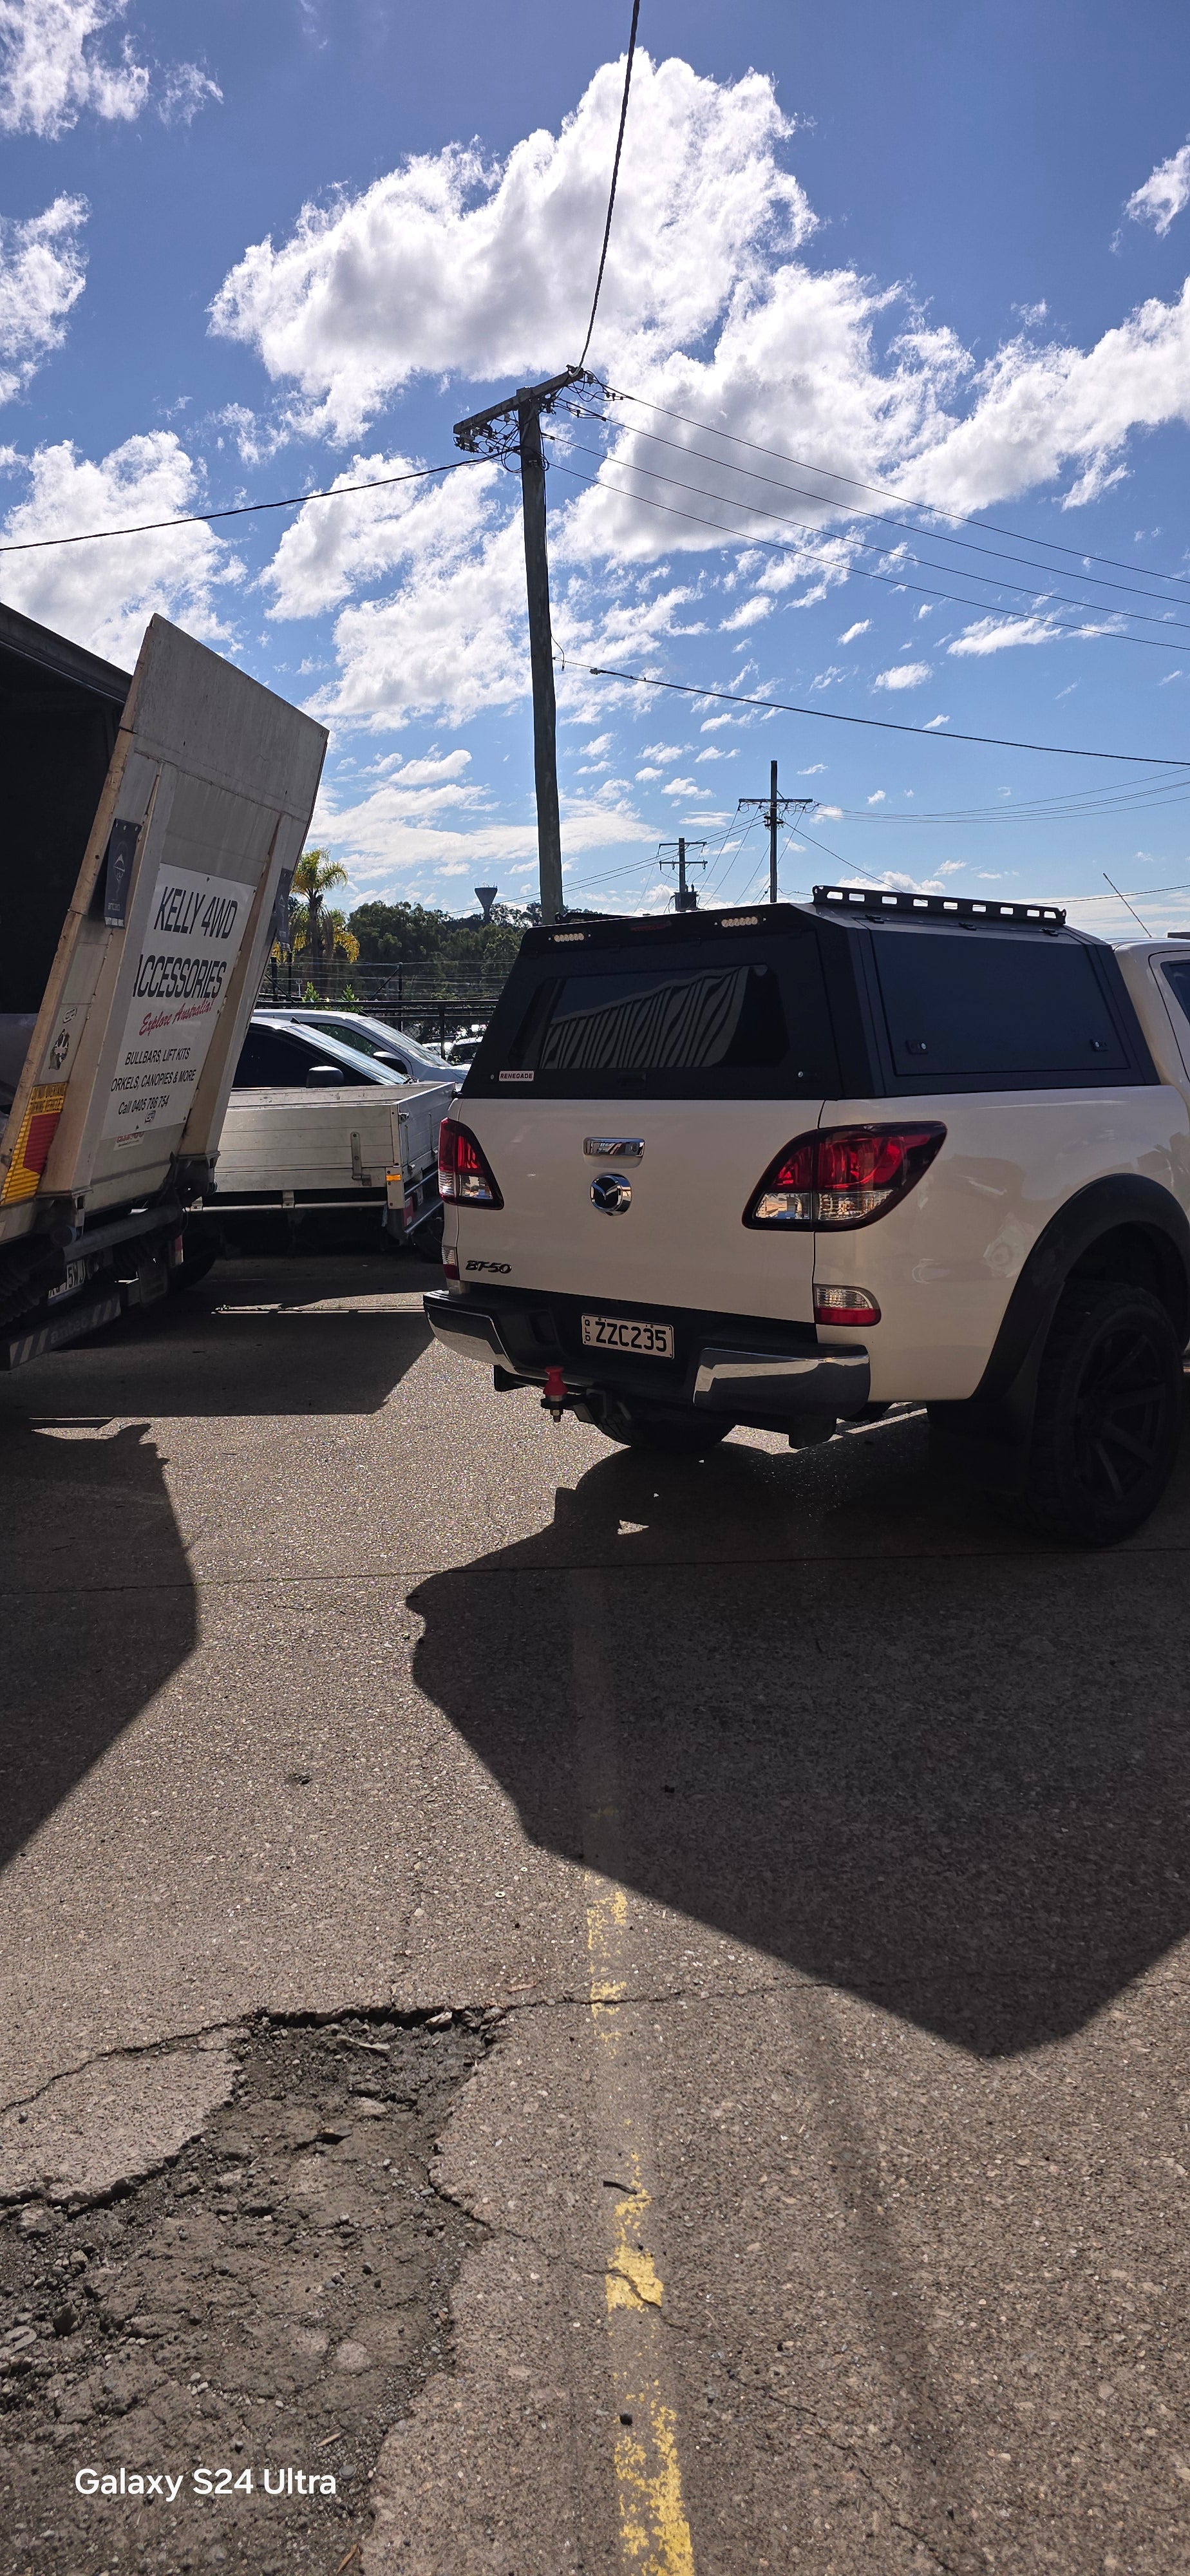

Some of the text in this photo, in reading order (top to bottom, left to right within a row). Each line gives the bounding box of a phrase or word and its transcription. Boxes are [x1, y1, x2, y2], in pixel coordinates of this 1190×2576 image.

[153, 886, 238, 939] KELLY 4WD
[139, 1010, 173, 1036] Explore
[125, 1047, 191, 1065] BULLBARS, LIFT KITS
[141, 1072, 173, 1088] CANOPIES
[173, 1071, 178, 1083] &
[178, 1069, 196, 1083] MORE
[118, 1095, 170, 1115] Call 0405 786 754
[466, 1260, 512, 1273] BT-50
[595, 1321, 667, 1352] ZZC235
